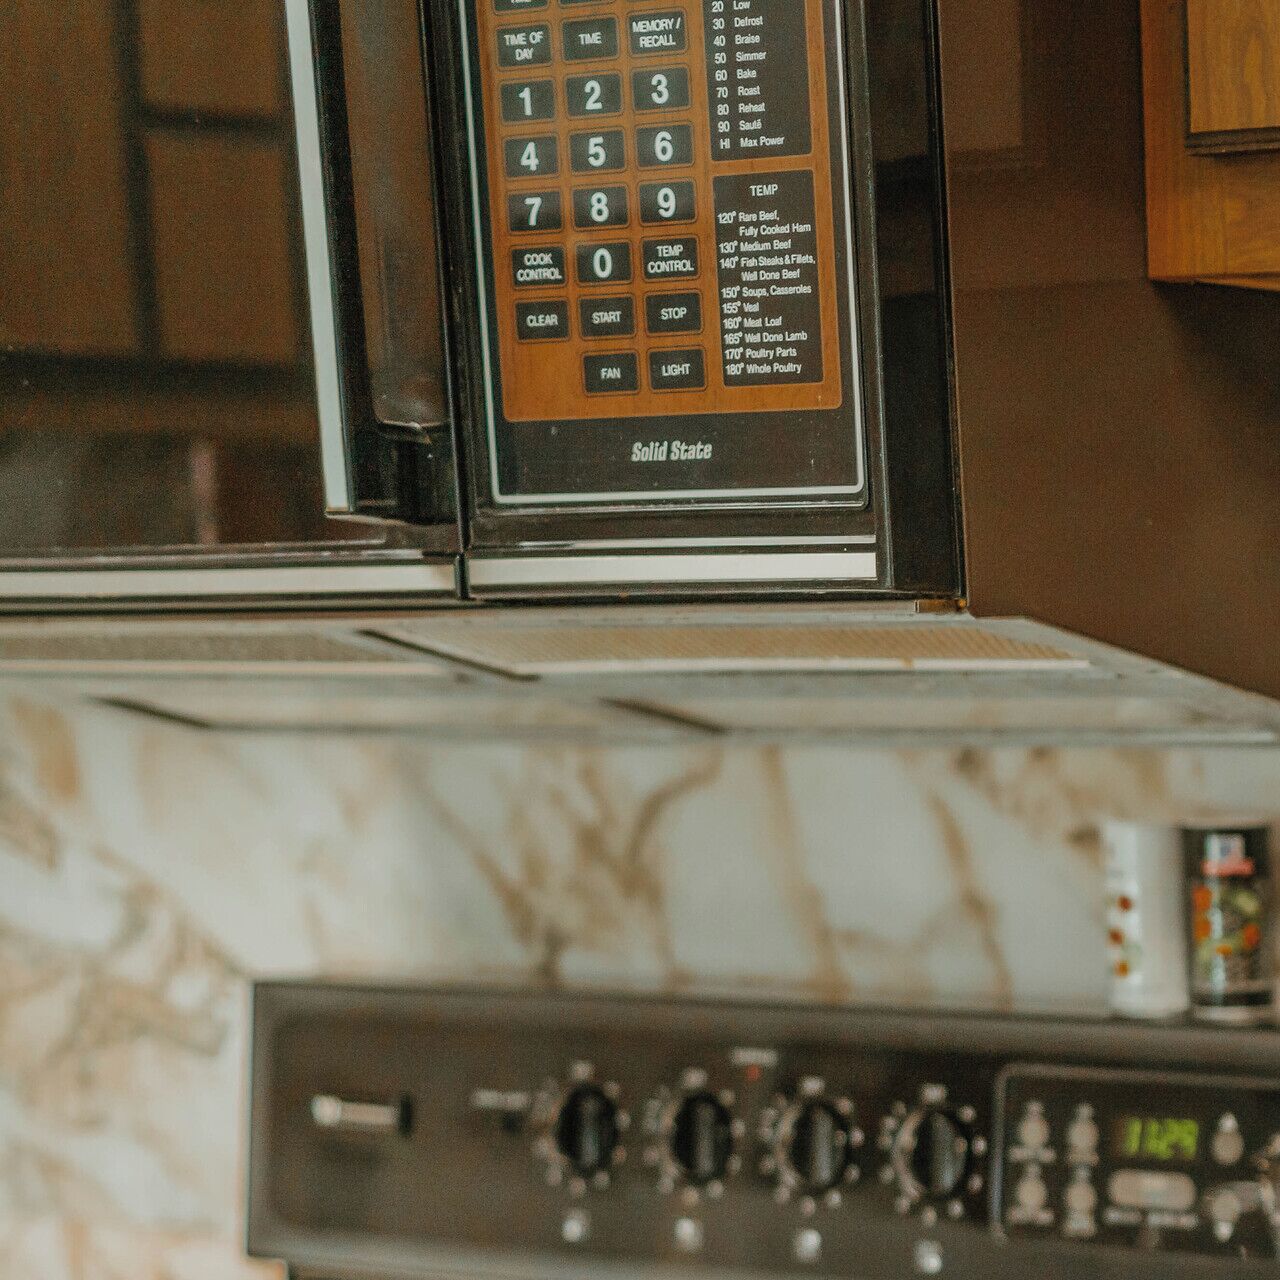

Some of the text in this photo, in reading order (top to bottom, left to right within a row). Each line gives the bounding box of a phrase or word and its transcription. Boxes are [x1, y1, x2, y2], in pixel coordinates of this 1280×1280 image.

[712, 0, 750, 12] 20 Low
[632, 19, 674, 33] MEMORY
[713, 16, 763, 30] 30 Defrost
[504, 31, 544, 46] TIME OF
[579, 32, 602, 45] TIME
[640, 34, 676, 48] RECALL
[713, 34, 760, 47] 40 Braise
[515, 48, 534, 60] DAY
[715, 51, 767, 64] 50 Simmer
[715, 69, 757, 81] 60 Bake
[585, 80, 602, 110] 2
[651, 74, 669, 104] 3
[716, 86, 761, 98] 70 Roast
[519, 87, 532, 116] 1
[717, 102, 765, 115] 80 Reheat
[718, 121, 730, 132] 90
[655, 131, 674, 162] 6
[720, 135, 785, 149] HI Max Power
[521, 142, 539, 171] 4
[588, 136, 606, 167] 5
[750, 184, 778, 196] TEMP
[591, 192, 609, 222] 8
[657, 187, 676, 218] 9
[525, 197, 542, 226] 7
[738, 212, 757, 223] Rare
[740, 223, 811, 237] Fully Cooked Ham
[656, 245, 684, 257] TEMP
[740, 239, 791, 252] Medium Beef
[524, 253, 552, 266] COOK
[593, 248, 612, 278] 0
[741, 257, 758, 267] Fish
[759, 255, 784, 266] Steaks
[647, 259, 695, 274] CONTROL
[516, 267, 562, 282] CONTROL
[742, 269, 800, 282] Well Done Beef
[770, 284, 812, 295] Casseroles
[661, 307, 687, 320] STOP
[743, 302, 760, 312] Veal
[526, 314, 558, 327] CLEAR
[592, 311, 621, 325] START
[744, 316, 782, 328] Meat Loaf
[745, 331, 808, 343] Well Done Lamb
[745, 347, 797, 359] Poultry Parts
[600, 368, 621, 380] FAN
[662, 363, 690, 376] LIGHT
[746, 363, 802, 374] Whole Poultry
[631, 440, 712, 461] Solid State
